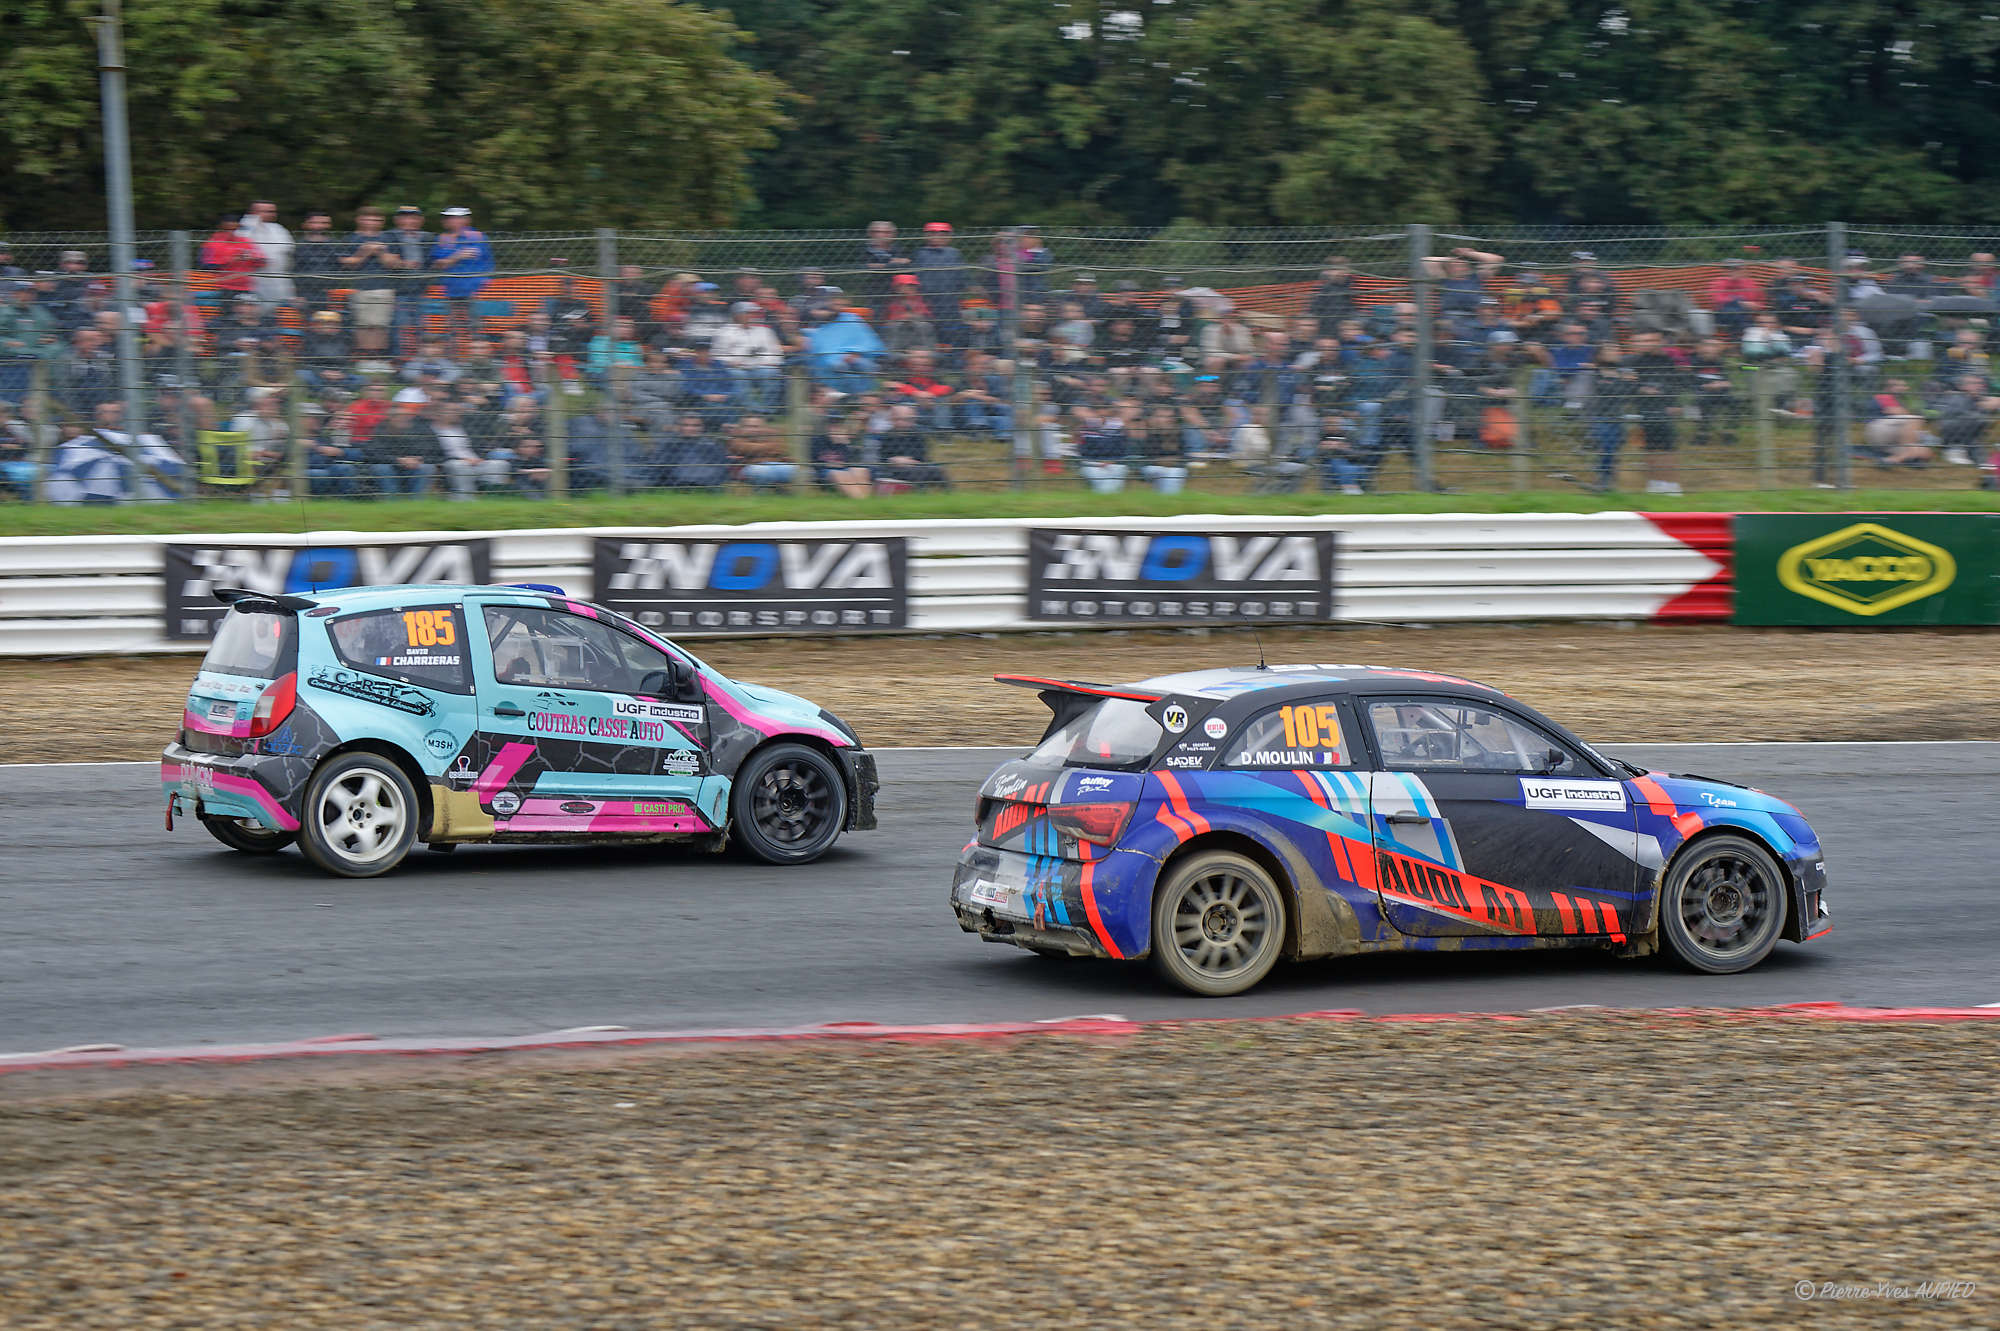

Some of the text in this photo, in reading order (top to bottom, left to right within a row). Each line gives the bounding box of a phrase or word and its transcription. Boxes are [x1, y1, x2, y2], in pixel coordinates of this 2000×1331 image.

[609, 543, 892, 590] NOVA
[1044, 535, 1321, 581] NOVA
[1041, 600, 1320, 616] MOTORSPORT
[403, 610, 456, 647] 185
[393, 656, 460, 666] CHARRIERAS
[616, 702, 647, 715] UGF
[527, 711, 664, 742] COUTRAS CASSE AUTO
[1279, 705, 1340, 748] 105
[1241, 751, 1314, 765] D.MOULIN
[1527, 788, 1562, 799] UGF
[643, 803, 686, 814] CASTI PRIX
[1379, 852, 1525, 930] AUDI A1
